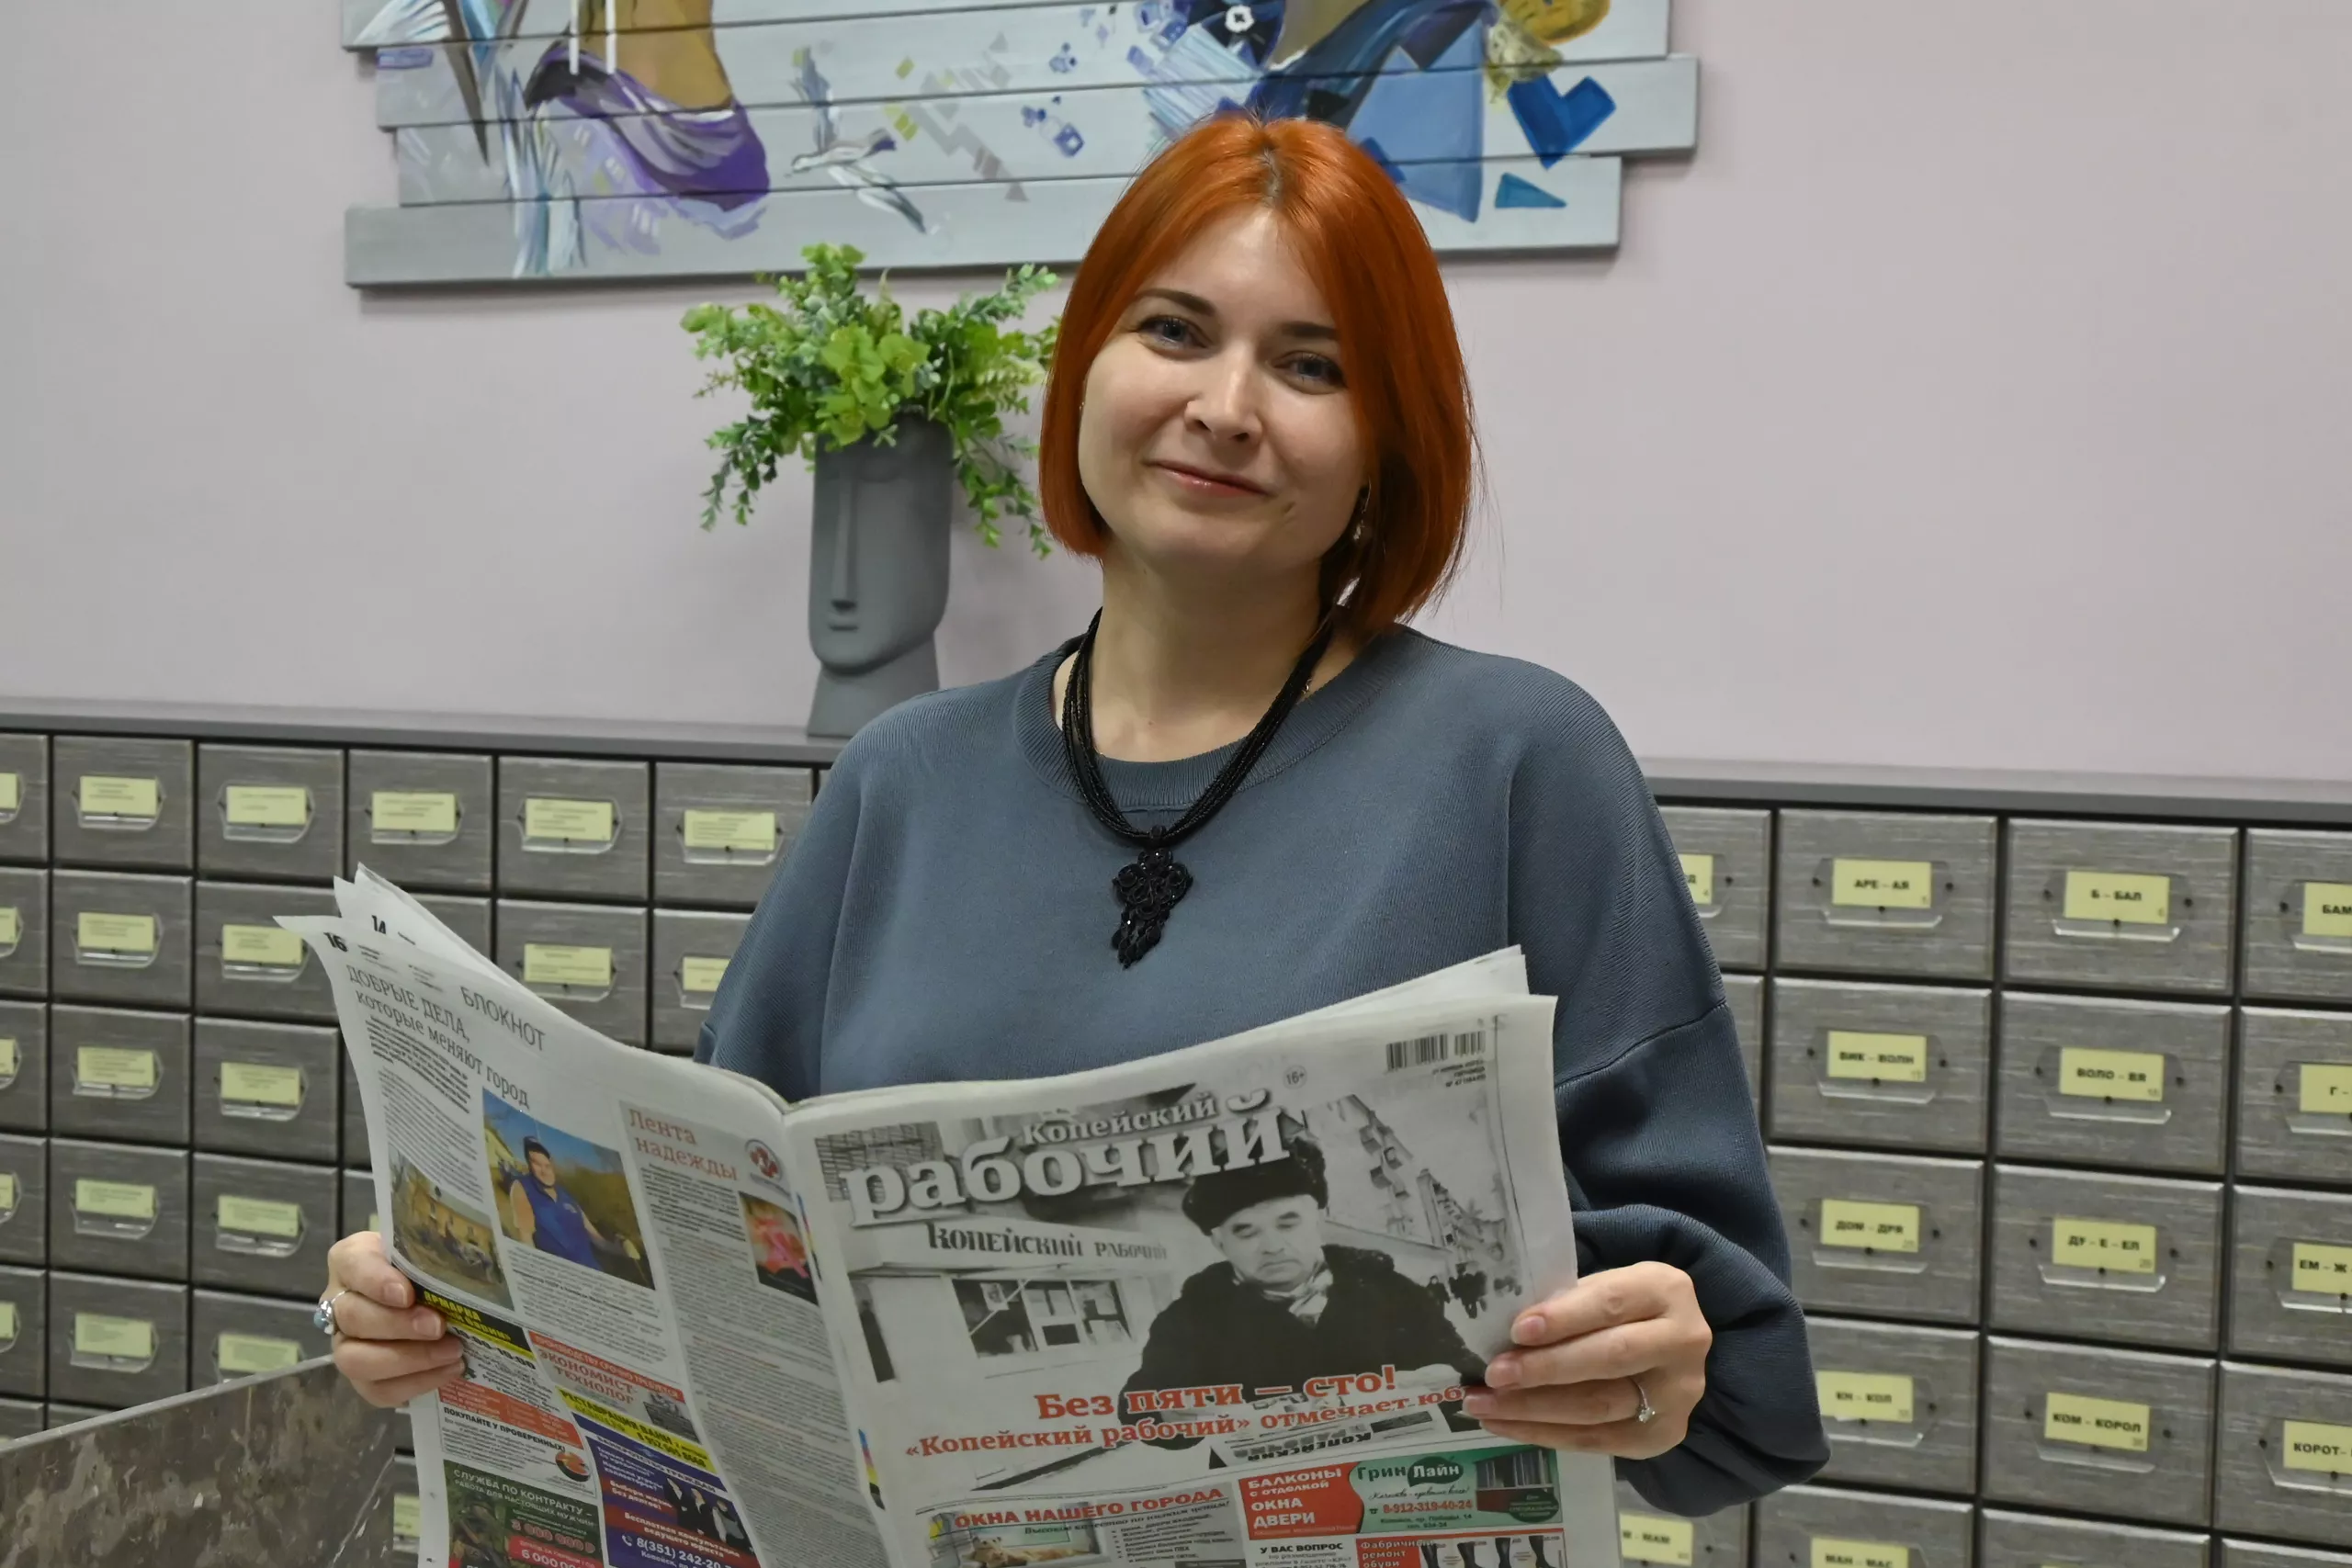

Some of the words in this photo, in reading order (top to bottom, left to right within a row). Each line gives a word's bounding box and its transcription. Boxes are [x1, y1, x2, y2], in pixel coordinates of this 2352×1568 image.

[323, 931, 348, 953] 16
[345, 964, 419, 1011] ДОБРЫЕ
[422, 997, 470, 1043] ДЕЛА,
[460, 986, 546, 1051] БЛОКНОТ
[356, 990, 424, 1034] которые
[427, 1027, 482, 1075] меняют
[486, 1066, 531, 1110] город
[1286, 1072, 1305, 1086] 16+
[628, 1109, 697, 1145] Лента
[1024, 1092, 1218, 1145] Копейский
[839, 1088, 1290, 1228] рабочий
[1034, 1393, 1114, 1419] Без
[1125, 1384, 1243, 1414] пяти
[1303, 1365, 1396, 1397] сто!
[905, 1425, 1093, 1457] «Копейский
[1101, 1415, 1250, 1449] рабочий»
[1261, 1396, 1410, 1429] отмечает
[1248, 1468, 1341, 1489] БАЛКОНЫ
[1357, 1466, 1407, 1483] Грин
[1413, 1463, 1460, 1478] Лайн
[453, 1468, 500, 1489] СЛУЖБА
[502, 1483, 517, 1495] ПО
[519, 1489, 583, 1516] КОНТРАКТУ
[1250, 1497, 1303, 1512] ОКНА
[955, 1510, 1020, 1529] ОКНА
[1026, 1501, 1124, 1523] НАШЕГО
[1131, 1488, 1225, 1513] ГОРОДА
[1253, 1512, 1315, 1529] ДВЕРИ
[634, 1536, 677, 1559] 8(351)
[1260, 1546, 1268, 1554] У
[1270, 1544, 1294, 1553] ВАС
[1295, 1541, 1343, 1552] ВОПРОС
[1361, 1549, 1407, 1560] ремонт
[1362, 1559, 1400, 1568] обуви
